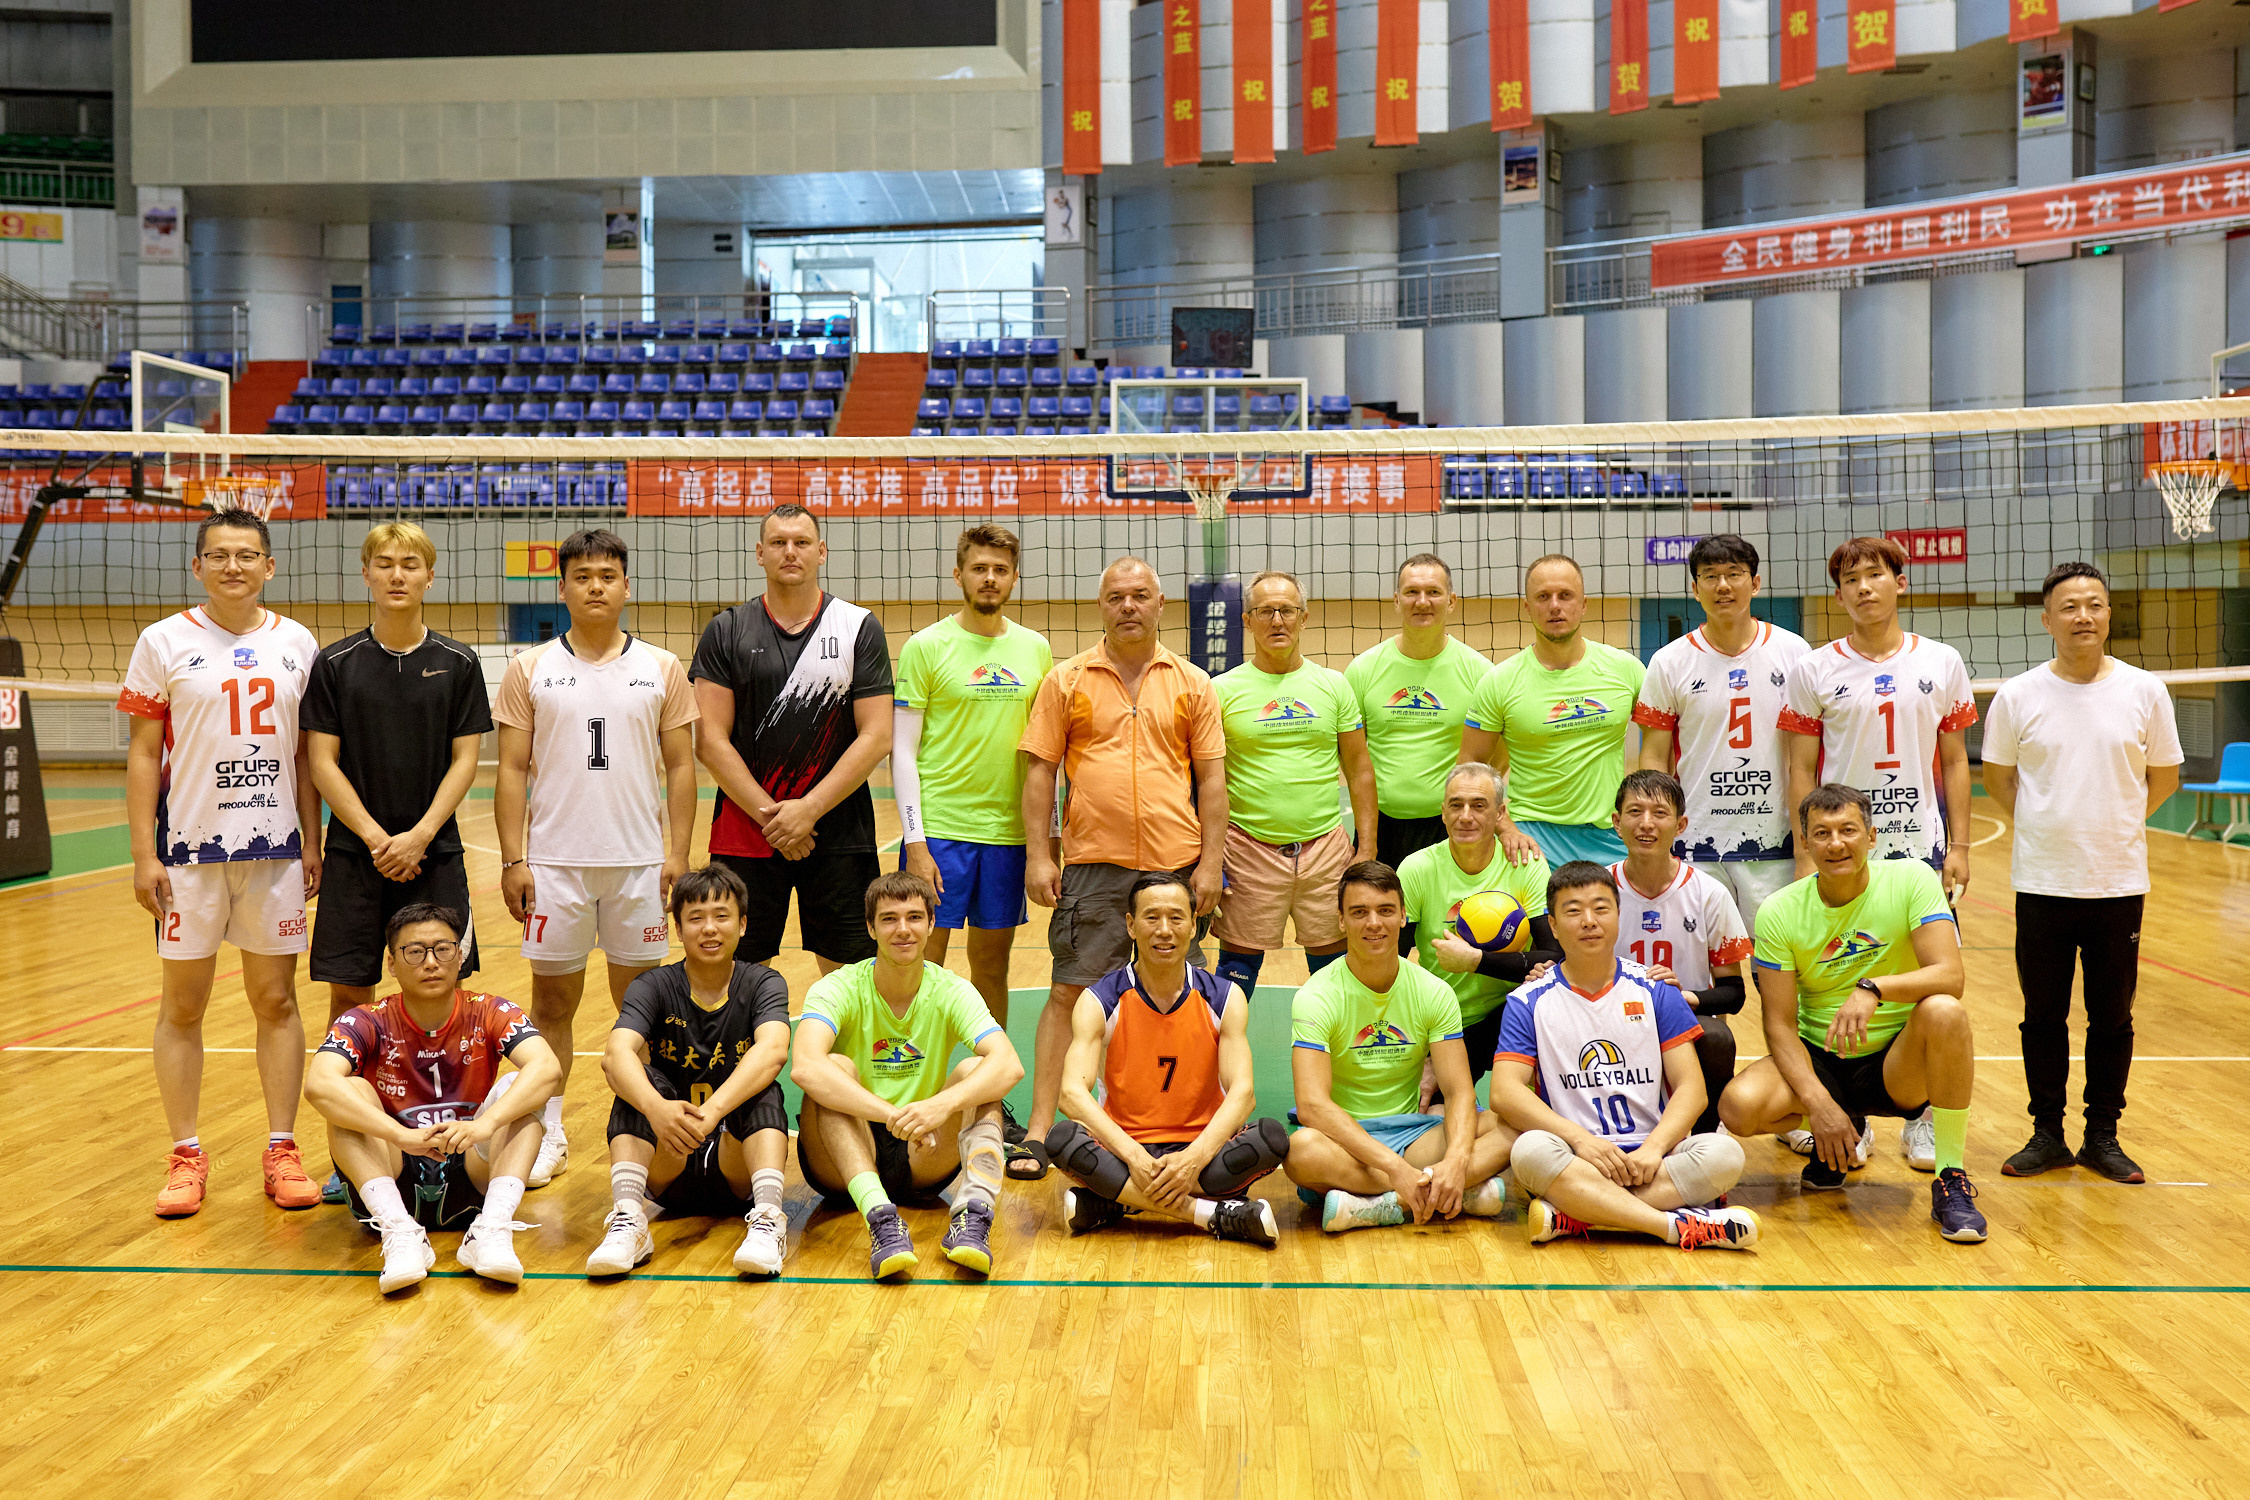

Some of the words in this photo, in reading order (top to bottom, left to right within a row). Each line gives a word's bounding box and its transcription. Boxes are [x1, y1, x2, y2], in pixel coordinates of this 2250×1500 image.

[1685, 17, 1710, 42] 祝
[1788, 10, 1808, 37] 祝
[1854, 10, 1888, 49] 贺
[1242, 79, 1266, 102] 祝
[1385, 78, 1409, 100] 祝
[1617, 62, 1641, 94] 贺
[1310, 86, 1329, 109] 祝
[1498, 80, 1522, 111] 贺
[1072, 110, 1093, 131] 祝
[1173, 99, 1194, 121] 祝
[1721, 204, 2012, 273] 全民健身利国利民
[529, 545, 558, 573] D
[820, 636, 839, 660] 10
[221, 677, 276, 736] 12
[1728, 697, 1752, 749] 5
[1878, 701, 1895, 755] 1
[588, 718, 608, 770] 1
[218, 800, 266, 810] PRODUCTS
[251, 793, 266, 801] AIR
[1872, 801, 1920, 814] ZOTY
[1710, 808, 1755, 816] PRODUCTS
[525, 913, 549, 944] 17
[417, 1048, 447, 1059] MIKAA
[428, 1062, 443, 1098] 1
[1158, 1056, 1178, 1092] 7
[1559, 1067, 1654, 1090] VOLLEYBALL
[376, 1080, 406, 1097] OMG
[1592, 1094, 1636, 1136] 10
